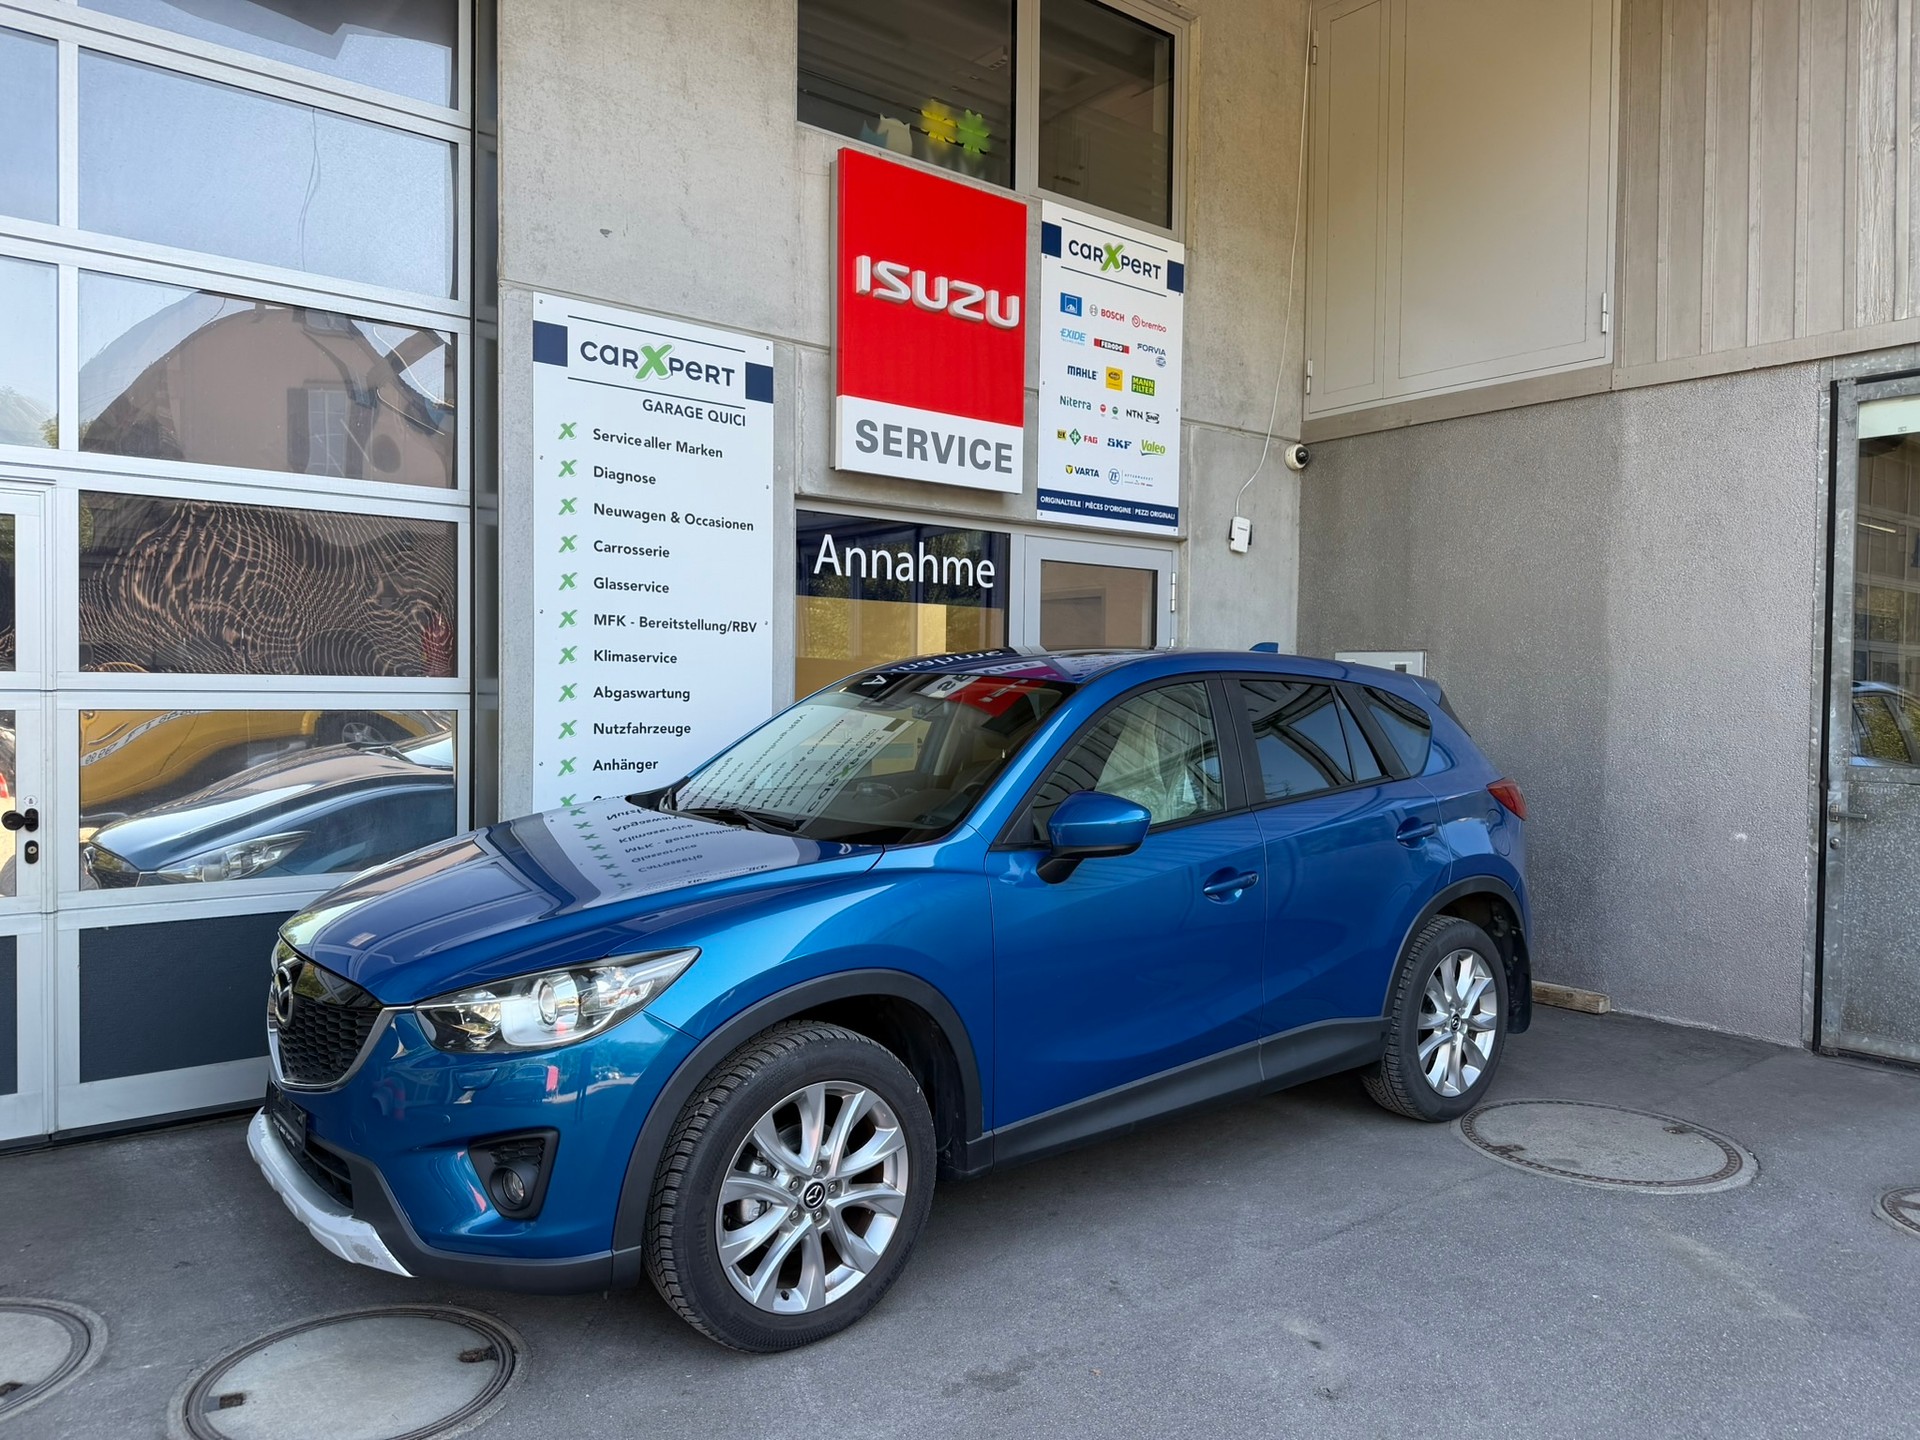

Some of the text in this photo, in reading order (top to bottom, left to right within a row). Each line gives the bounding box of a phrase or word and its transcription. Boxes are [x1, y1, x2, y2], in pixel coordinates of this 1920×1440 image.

[855, 254, 1020, 330] ISUZU
[1101, 308, 1125, 322] BOSCH
[1141, 320, 1167, 333] brembo
[1060, 328, 1087, 342] EXIDE
[1137, 343, 1167, 356] FORVIA
[1067, 365, 1097, 380] MAHLE
[1133, 377, 1154, 388] MANN
[1133, 384, 1154, 395] FILTER
[1059, 395, 1092, 411] Niterra
[642, 398, 746, 427] GARAGE QUICI
[1126, 409, 1144, 420] NTN
[593, 428, 723, 458] Service aller Marken
[855, 419, 1013, 474] SERVICE
[1083, 435, 1098, 444] FAG
[1107, 437, 1132, 450] SKF
[1141, 439, 1166, 455] Valeo
[593, 465, 657, 485] Diagnose
[1074, 466, 1100, 478] VARTA
[1040, 496, 1081, 508] ORIGINALTEILE
[1104, 504, 1132, 515] D'ORIGINE
[1135, 508, 1149, 516] PEZZI
[1150, 510, 1176, 520] ORIGINALI
[593, 502, 754, 532] Neuwagen & Occasionen
[593, 540, 670, 559] Carrosserie
[813, 533, 996, 589] Annahme
[593, 577, 670, 593] Glasservice
[593, 613, 626, 627] MFK
[639, 616, 757, 635] Bereitstellung/RBV
[593, 650, 678, 664] Klimaservice
[593, 685, 691, 702] Abgaswartung
[593, 722, 691, 737] Nutzfahrzeuge
[592, 758, 659, 773] Anhänger
